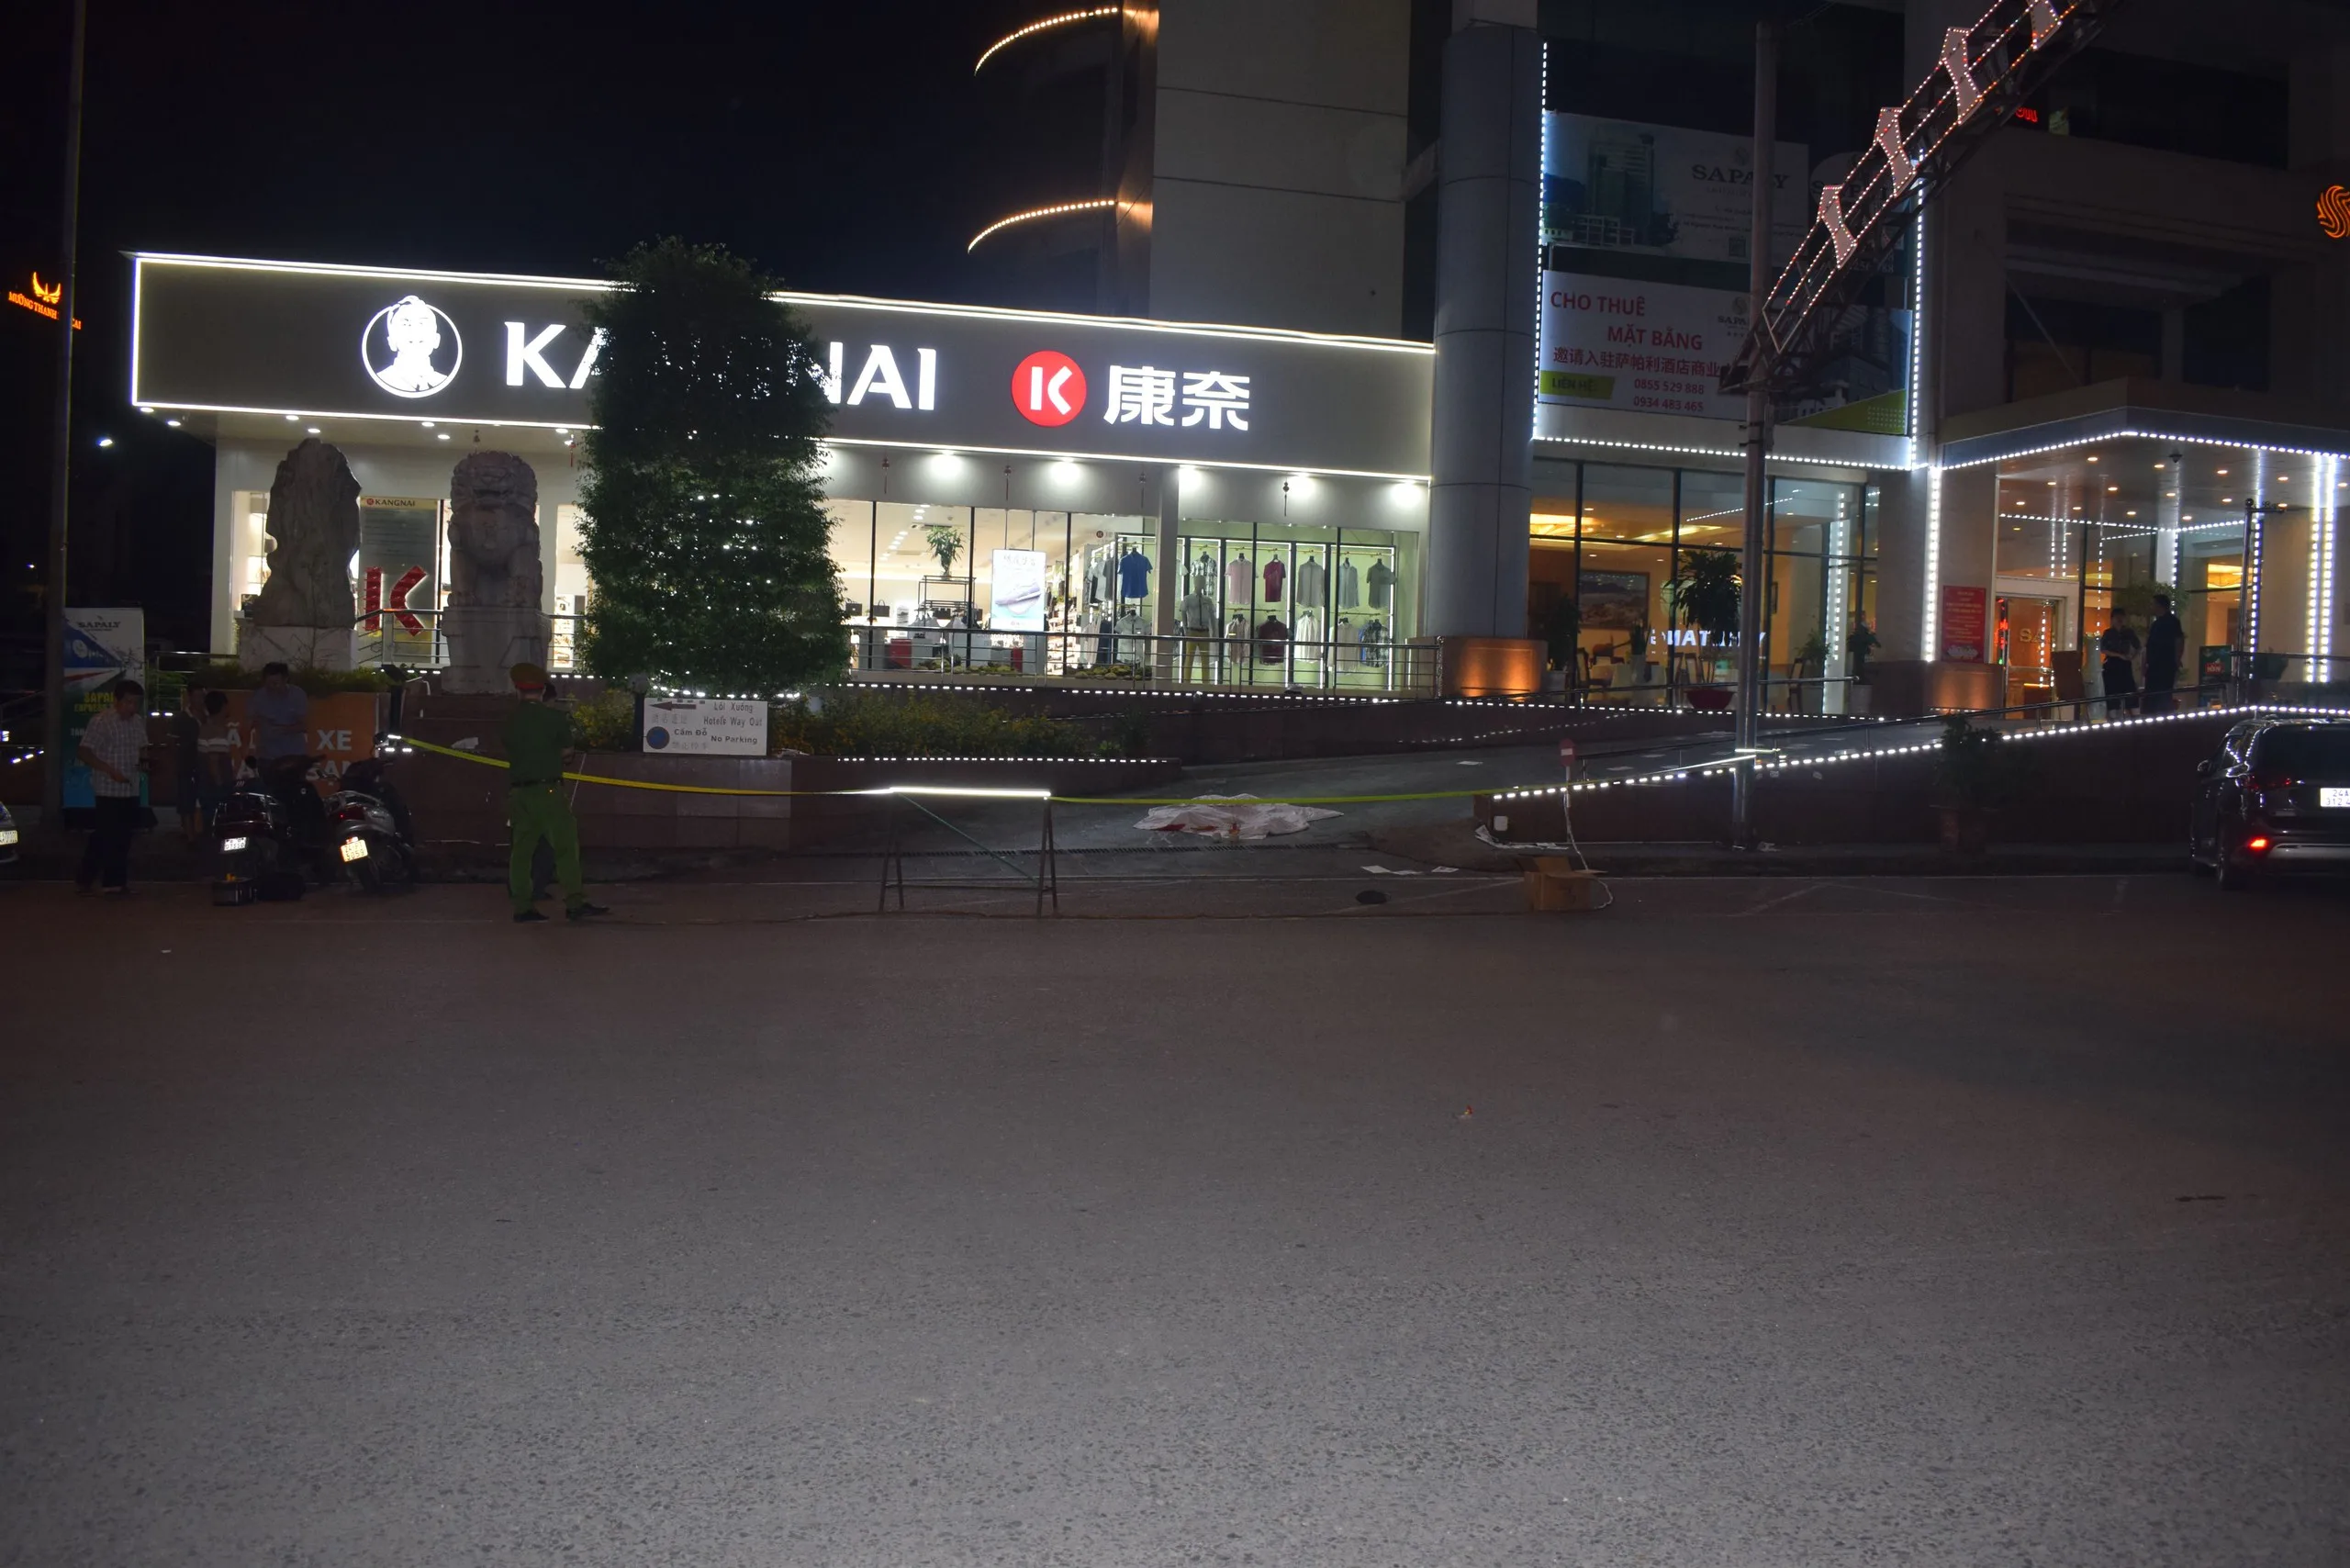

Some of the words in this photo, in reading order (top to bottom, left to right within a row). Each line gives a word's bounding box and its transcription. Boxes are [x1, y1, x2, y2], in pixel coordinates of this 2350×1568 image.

[1692, 163, 1790, 189] SAPAY
[34, 301, 59, 320] THANH
[1550, 291, 1591, 310] CHO
[1596, 296, 1646, 317] THUÊ
[1718, 315, 1748, 326] SAPA
[1607, 323, 1647, 348] MẶT
[1552, 347, 1730, 377] 邀请入驻萨帕利酒店商业
[1634, 378, 1660, 391] 0855
[1662, 380, 1682, 393] 529
[1685, 382, 1705, 395] 888
[1103, 364, 1250, 431] 康奈
[1633, 396, 1659, 409] 0934
[1662, 398, 1682, 410] 483
[375, 498, 416, 507] KANGNAI
[730, 717, 745, 728] Way
[749, 717, 762, 726] Out
[317, 729, 352, 751] XE
[725, 735, 758, 745] Parking
